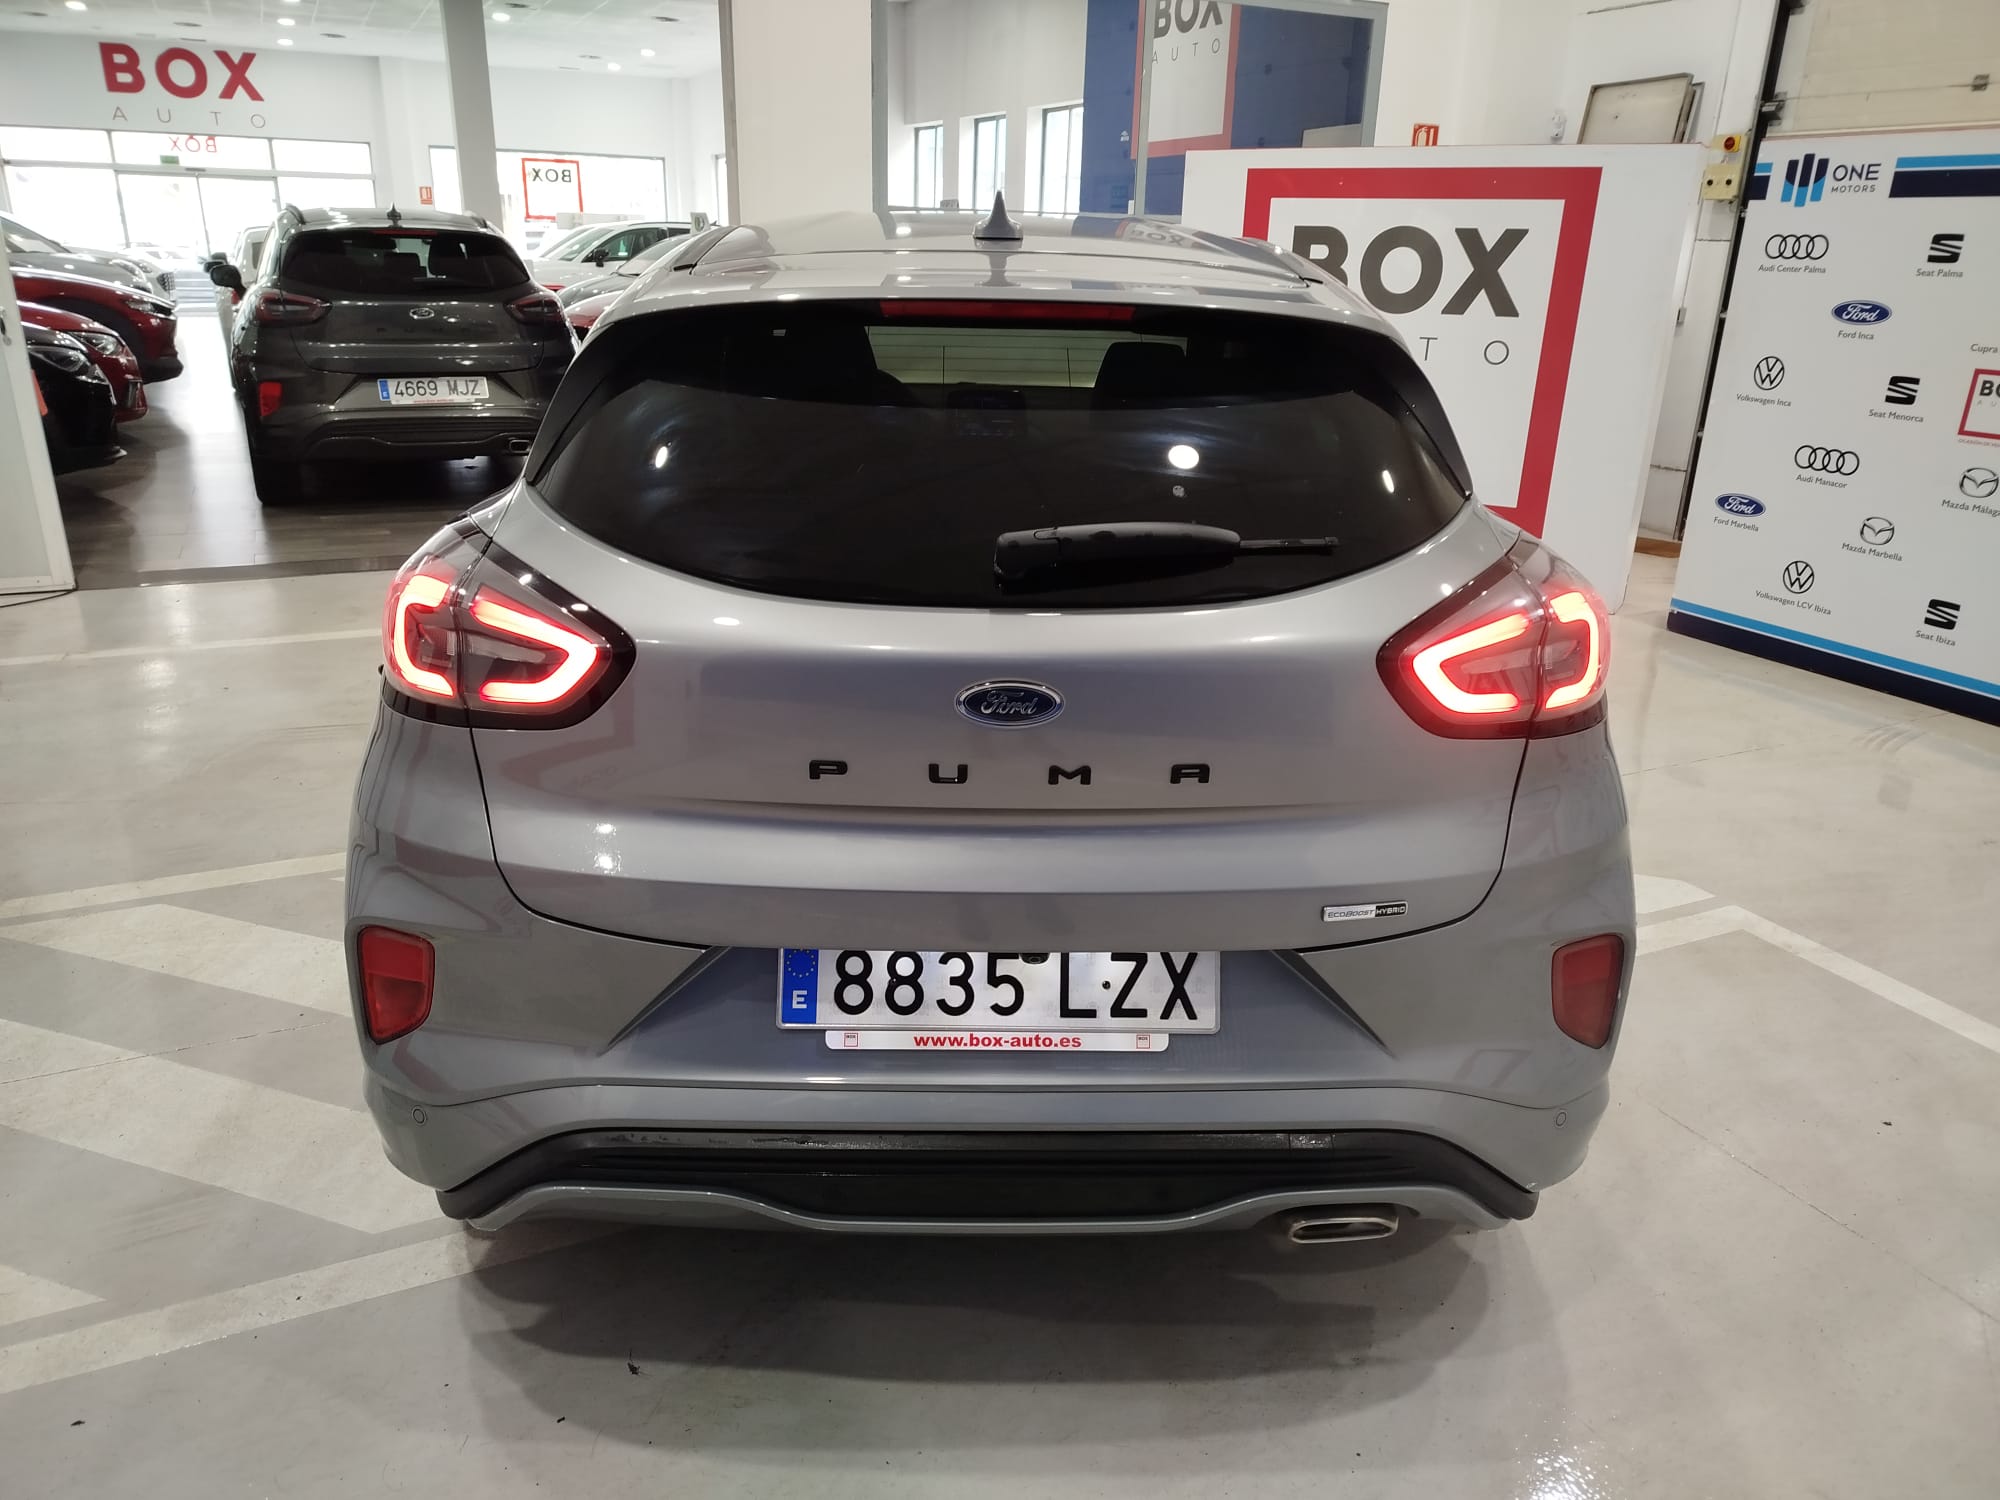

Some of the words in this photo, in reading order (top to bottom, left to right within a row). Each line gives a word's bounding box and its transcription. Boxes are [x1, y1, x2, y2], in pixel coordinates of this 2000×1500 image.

[98, 41, 265, 101] BOX
[112, 106, 266, 129] AUTO
[1832, 163, 1882, 182] ONE
[1831, 184, 1876, 193] MOTORS
[1758, 264, 1775, 273] Audi
[1776, 265, 1801, 273] Center
[1803, 265, 1827, 274] Palma
[1915, 268, 1935, 278] Seat
[1937, 268, 1964, 278] Palma
[1842, 303, 1881, 322] Ford
[1837, 330, 1857, 339] Ford
[1858, 331, 1875, 340] Inca
[1419, 336, 1510, 365] TO
[1970, 343, 1998, 354] Cupra
[394, 380, 438, 397] 4669
[446, 379, 481, 396] MJZ
[1736, 393, 1776, 406] Volkswagen
[1776, 398, 1792, 407] Inca
[1868, 408, 1886, 418] Seat
[1888, 411, 1924, 423] Menorca
[1796, 474, 1813, 484] Audi
[1815, 477, 1848, 489] Manacor
[1724, 496, 1757, 515] Ford
[1941, 499, 1970, 511] Mazda
[1713, 516, 1729, 526] Ford
[1730, 520, 1759, 532] Marbella
[1841, 542, 1867, 555] Mazda
[1868, 547, 1903, 562] Marbella
[1755, 589, 1796, 607] Volkswagen
[1797, 600, 1813, 611] LCV
[1814, 604, 1832, 616] Ibiza
[1915, 629, 1934, 641] Seat
[1935, 634, 1956, 646] Ibiza
[980, 689, 1038, 715] Ford
[809, 760, 1210, 785] PUMA
[1376, 906, 1406, 915] HYBRID
[833, 949, 1025, 1017] 8835
[1060, 951, 1199, 1020] LZX
[792, 990, 807, 1008] E
[913, 1033, 1083, 1049] www.box-auto.es
